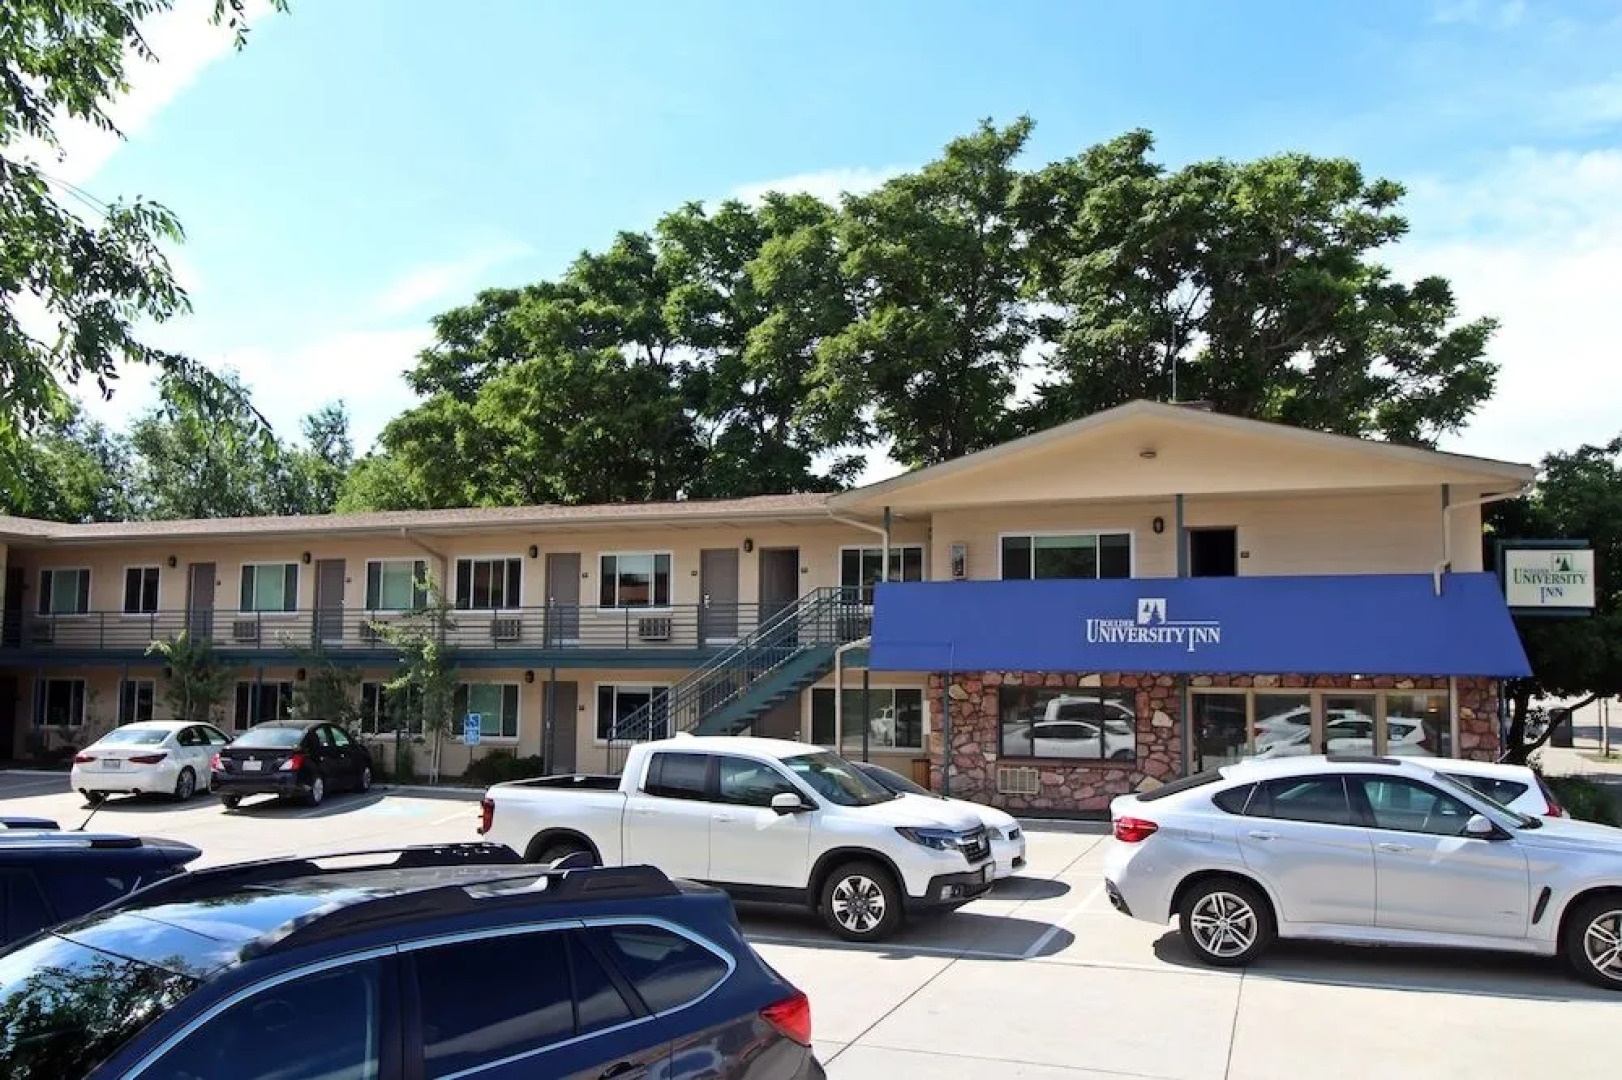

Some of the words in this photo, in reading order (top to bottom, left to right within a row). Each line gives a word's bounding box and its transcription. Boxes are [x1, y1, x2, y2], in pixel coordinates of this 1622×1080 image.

[1513, 568, 1586, 584] UNIVERSITY
[1540, 586, 1563, 604] INN
[1086, 619, 1186, 643] UNIVERSITY
[1187, 627, 1221, 652] INN
